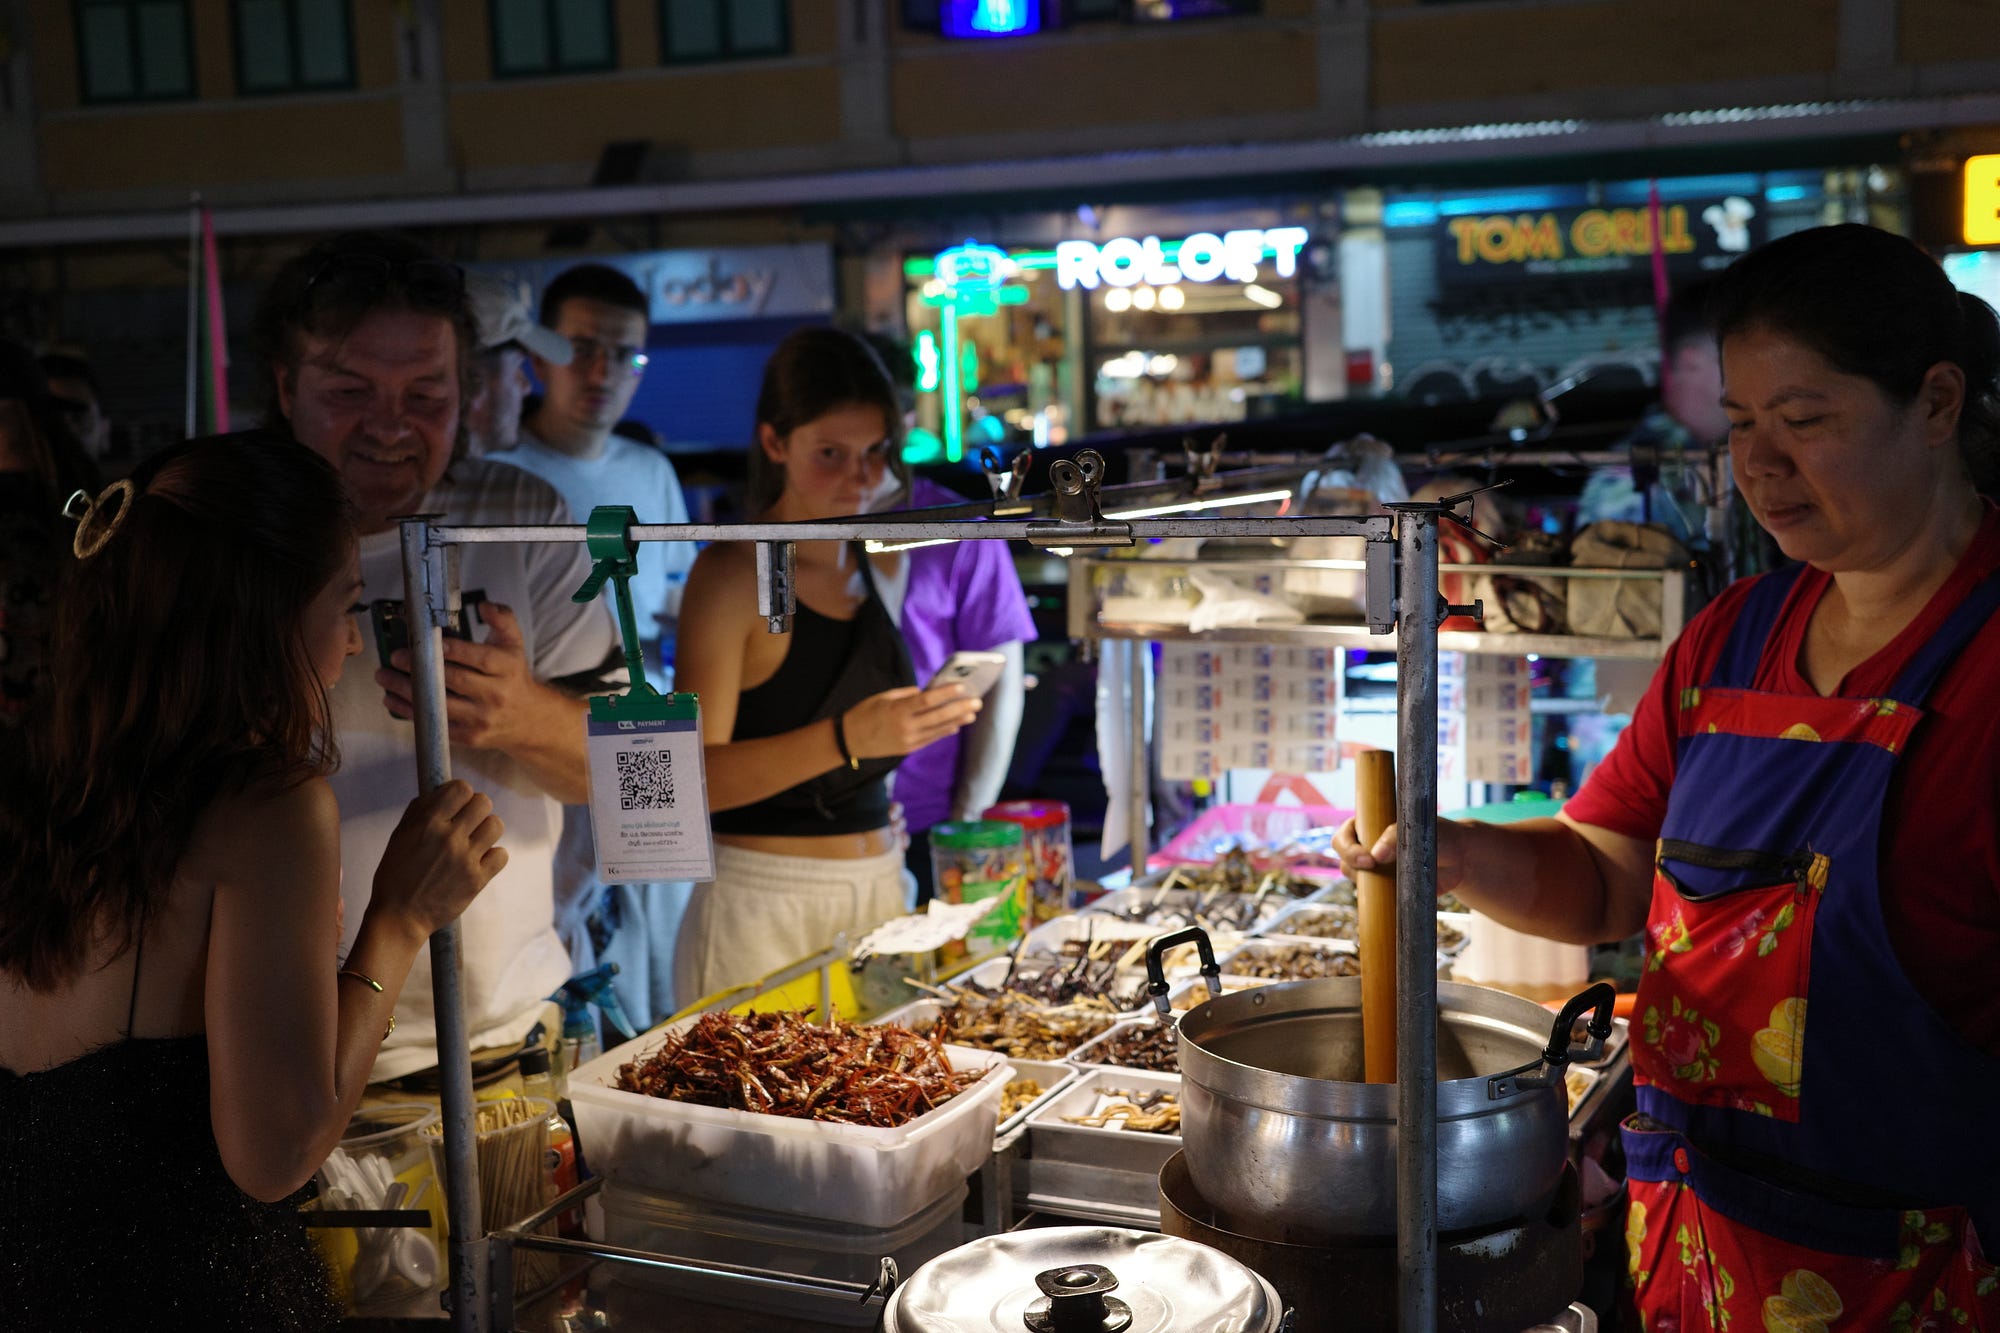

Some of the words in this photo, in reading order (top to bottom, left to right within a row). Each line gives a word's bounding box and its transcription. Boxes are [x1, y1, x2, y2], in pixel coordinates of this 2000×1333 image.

[1056, 227, 1309, 290] ROLOFT
[1449, 212, 1564, 265] TOM
[1571, 205, 1697, 257] GRILL
